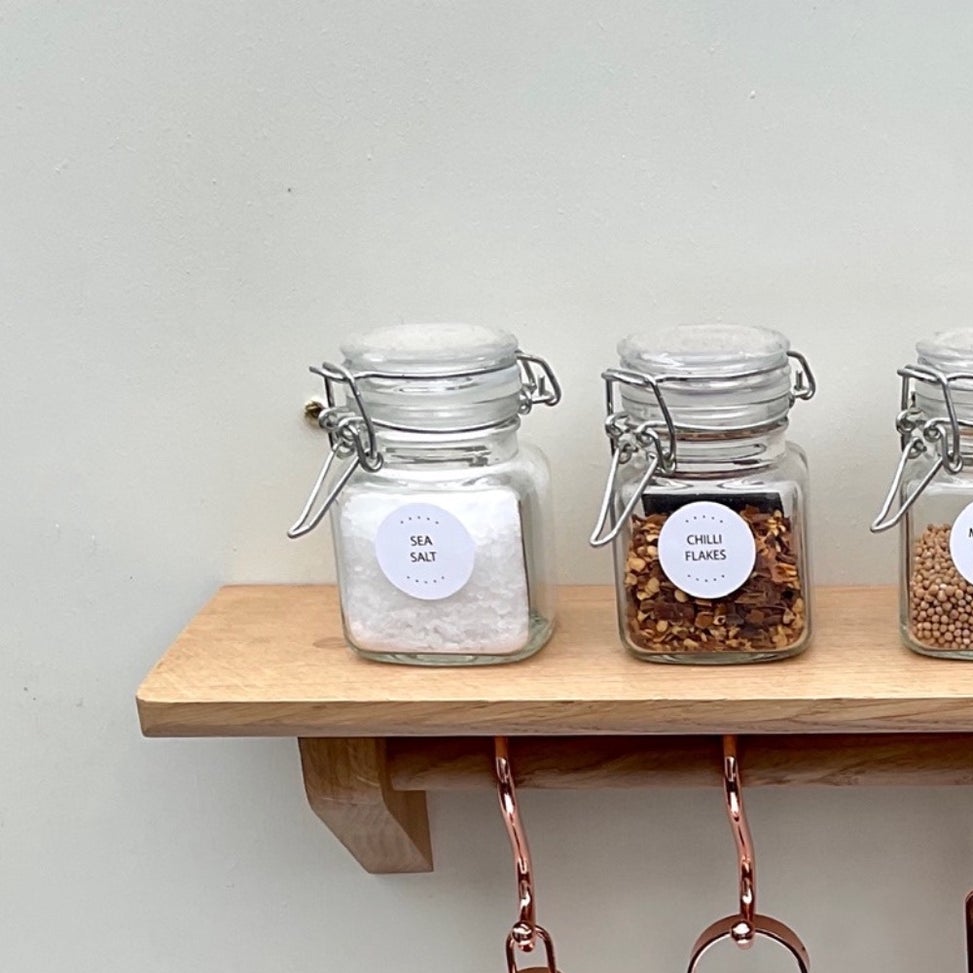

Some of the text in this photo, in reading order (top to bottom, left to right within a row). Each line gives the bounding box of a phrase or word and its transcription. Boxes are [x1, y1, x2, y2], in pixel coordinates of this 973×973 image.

[410, 535, 433, 547] SEA
[686, 534, 723, 546] CHILLI
[409, 551, 437, 563] SALT
[684, 548, 727, 562] FLAKES
